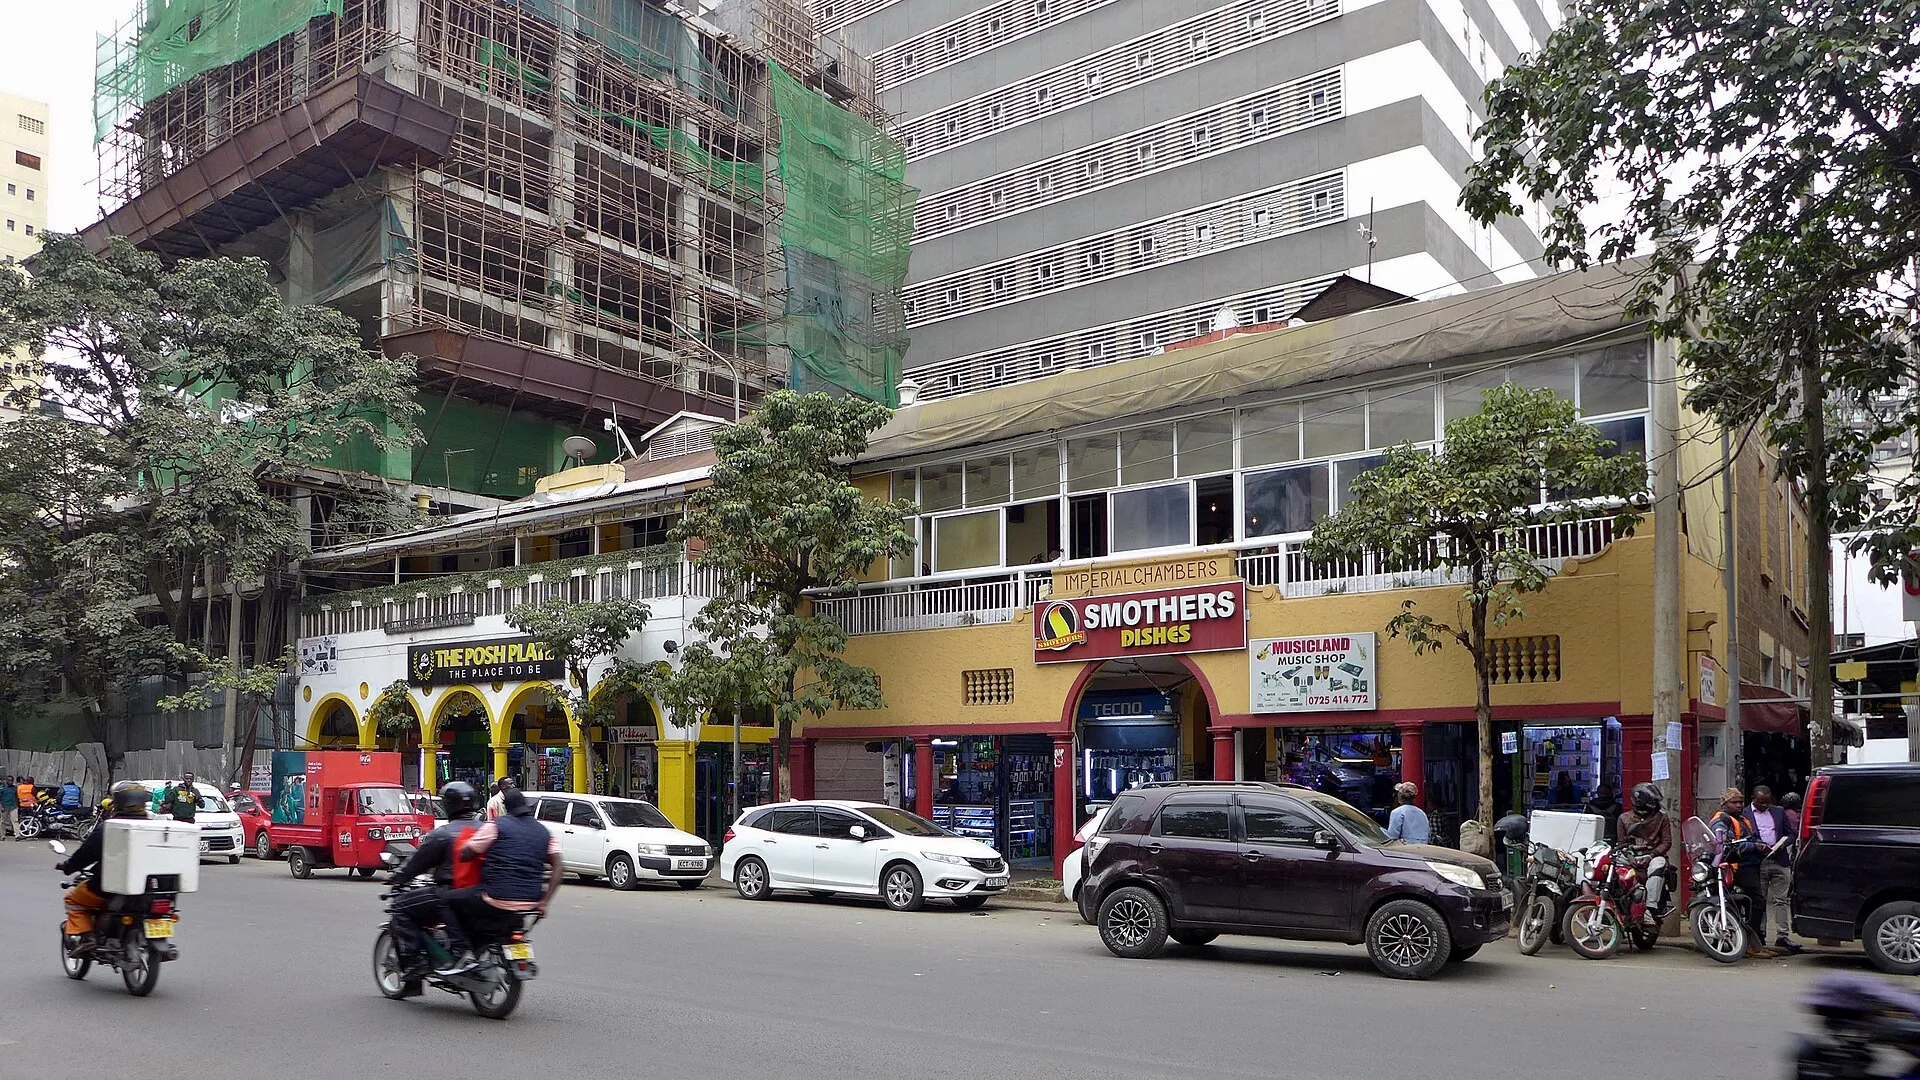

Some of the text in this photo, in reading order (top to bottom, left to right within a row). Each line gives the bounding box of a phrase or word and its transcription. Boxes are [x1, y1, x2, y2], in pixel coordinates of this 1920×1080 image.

[1065, 560, 1218, 590] IMPERIAL CHAMBERS
[1083, 591, 1236, 629] SMOTHERS
[1036, 632, 1084, 649] SMOTHERS
[1121, 624, 1191, 648] DISHES
[1272, 637, 1351, 655] MUSICLAND
[434, 648, 463, 668] THE
[464, 645, 506, 667] POSH
[1277, 654, 1346, 666] MUSIC SHOP
[448, 664, 541, 679] THE PLACE TO BE
[1308, 696, 1330, 705] 0725
[1332, 695, 1349, 704] 414
[1351, 694, 1368, 704] 772
[1091, 701, 1142, 716] TECNO
